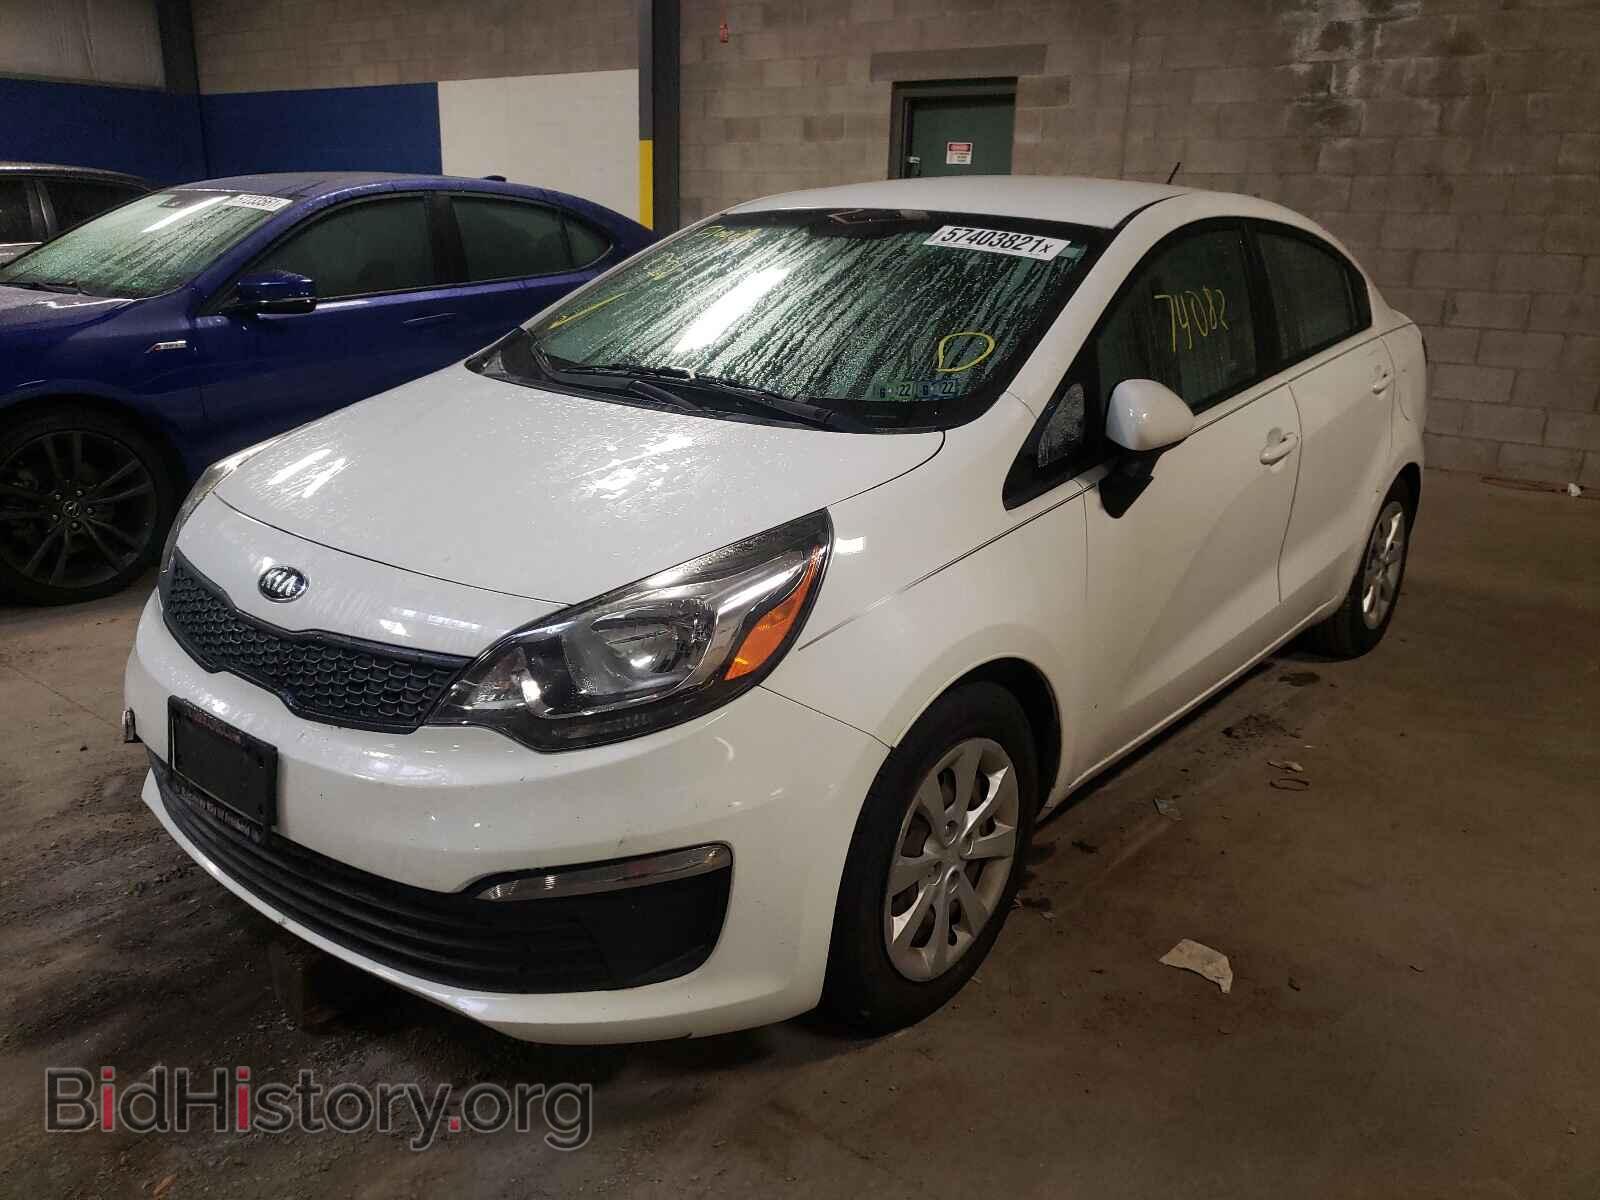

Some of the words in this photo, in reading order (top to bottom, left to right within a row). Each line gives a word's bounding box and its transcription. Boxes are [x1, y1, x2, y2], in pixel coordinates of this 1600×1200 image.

[899, 383, 912, 397] 22
[942, 381, 954, 394] 22
[264, 570, 299, 597] KIA
